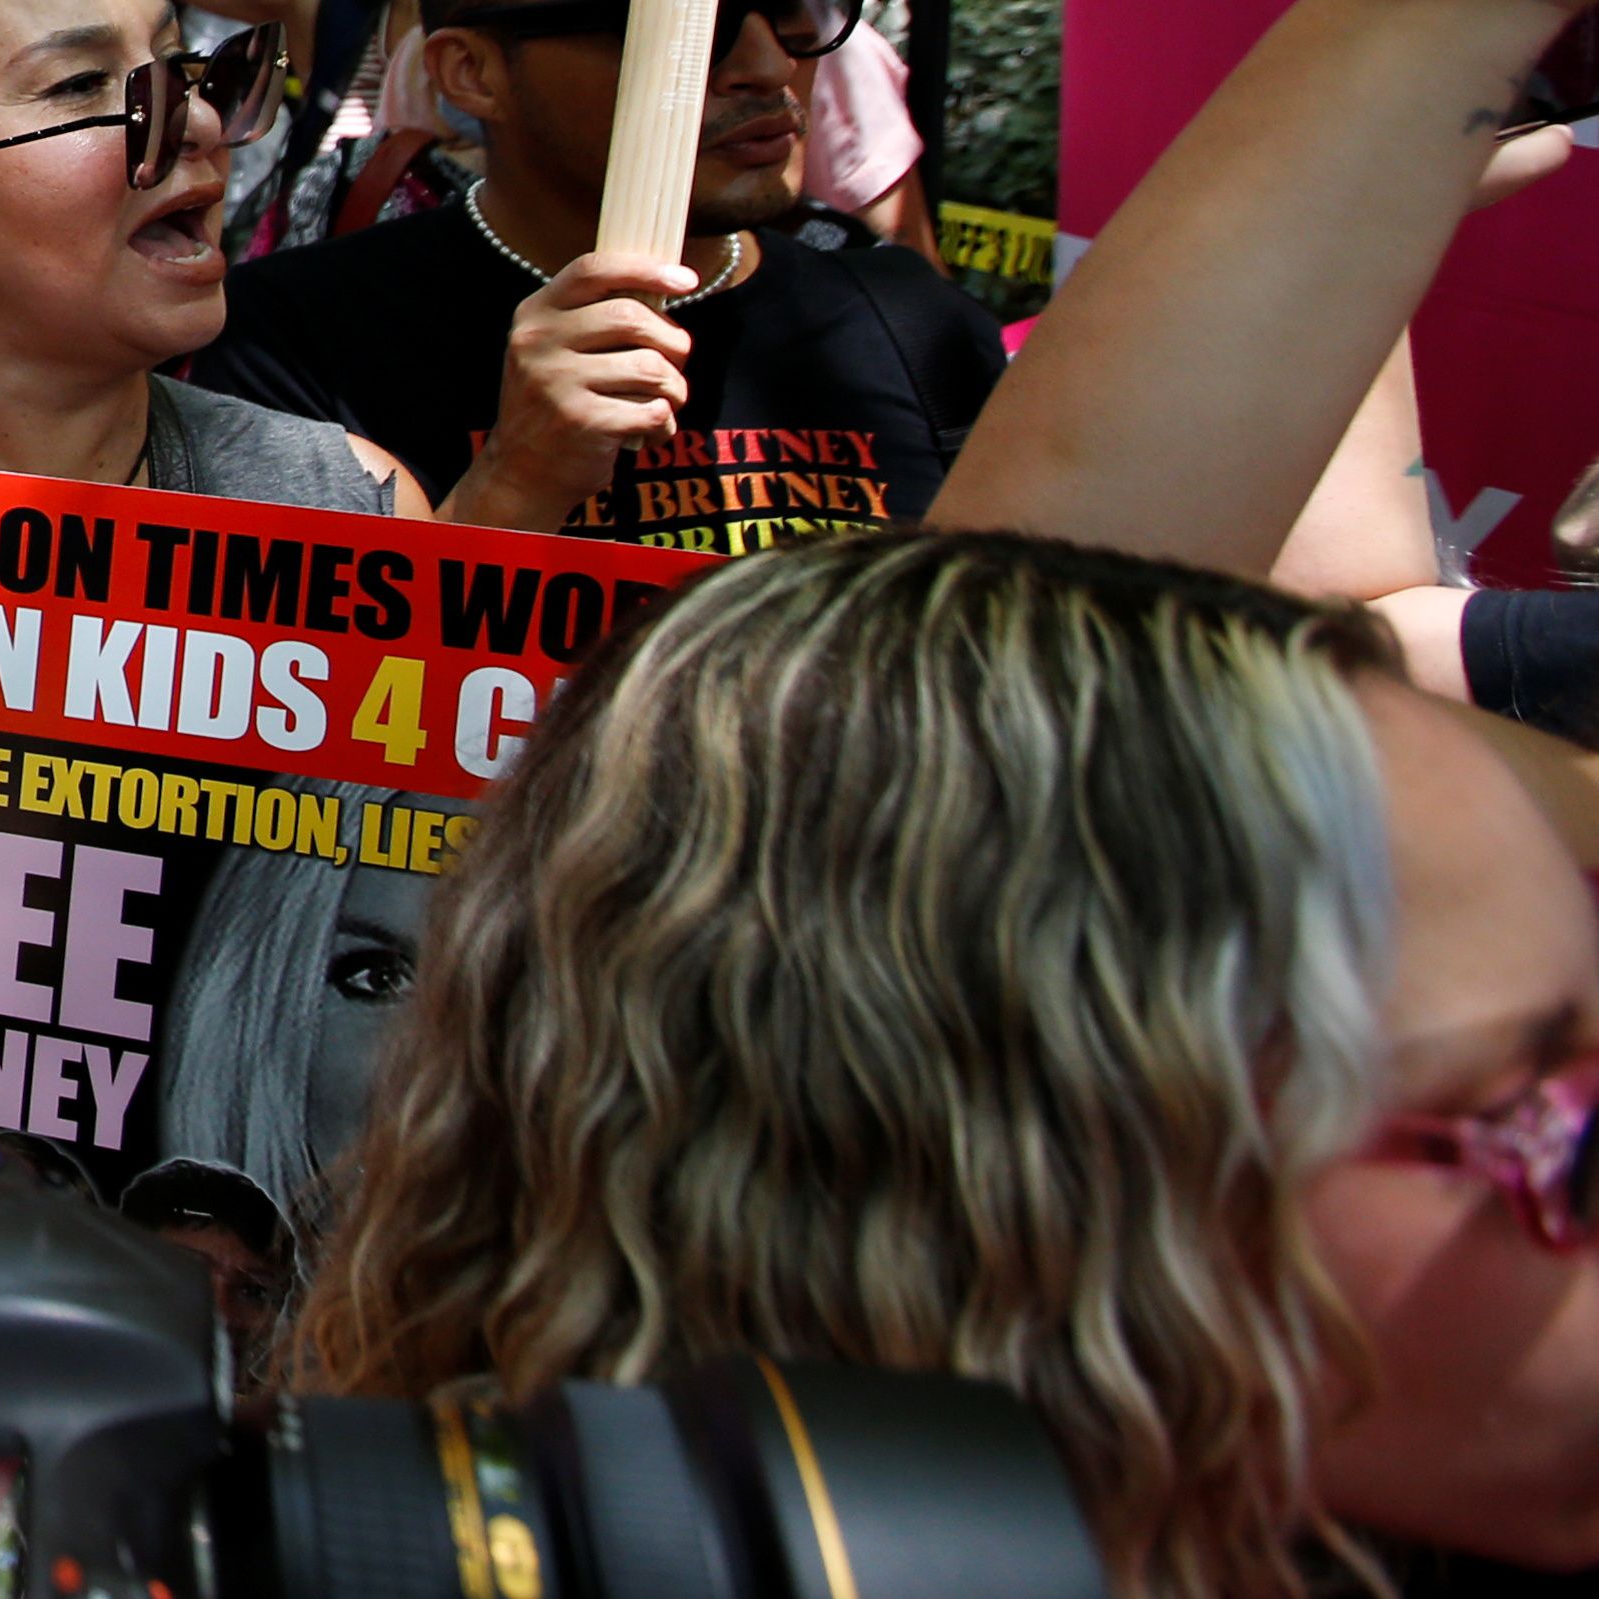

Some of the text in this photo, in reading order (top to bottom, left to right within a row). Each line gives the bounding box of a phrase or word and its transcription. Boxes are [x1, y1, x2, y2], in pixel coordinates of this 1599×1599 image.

[635, 427, 879, 469] BRITNEY
[636, 471, 889, 521] BRITNEY
[133, 520, 414, 643] TIMES
[63, 612, 330, 752] KIDS
[350, 656, 428, 766] 4
[19, 750, 350, 869] EXTORTION,
